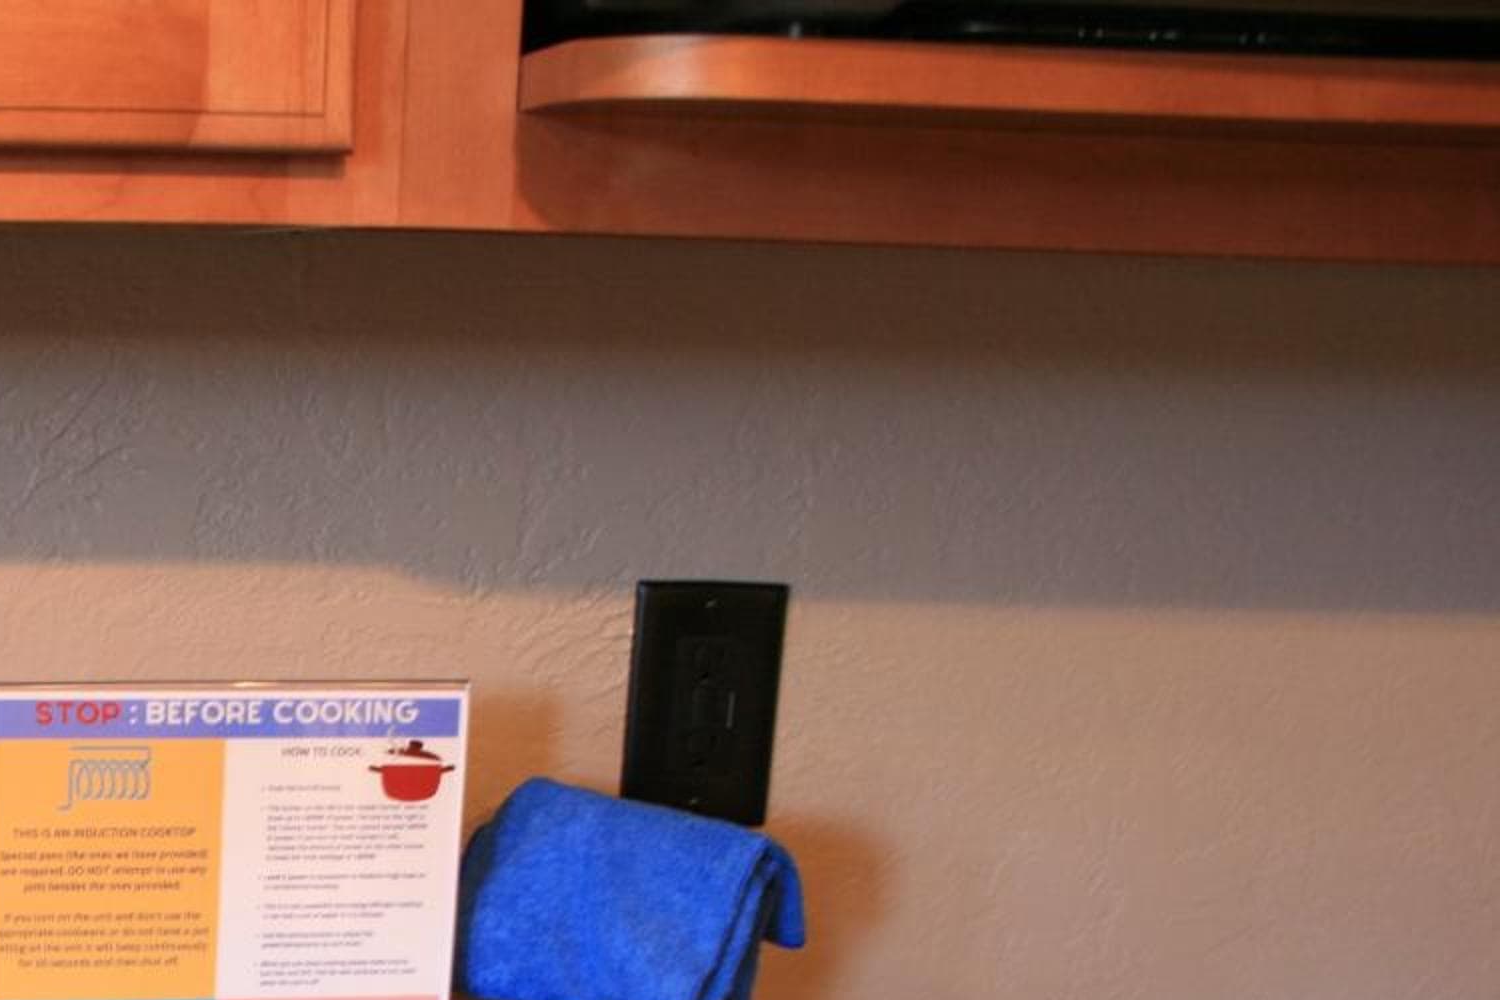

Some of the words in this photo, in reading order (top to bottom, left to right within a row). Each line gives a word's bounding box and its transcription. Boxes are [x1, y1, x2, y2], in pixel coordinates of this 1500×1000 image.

[35, 701, 123, 727] STOP
[145, 700, 262, 726] BEFORE
[273, 700, 420, 725] COOKING
